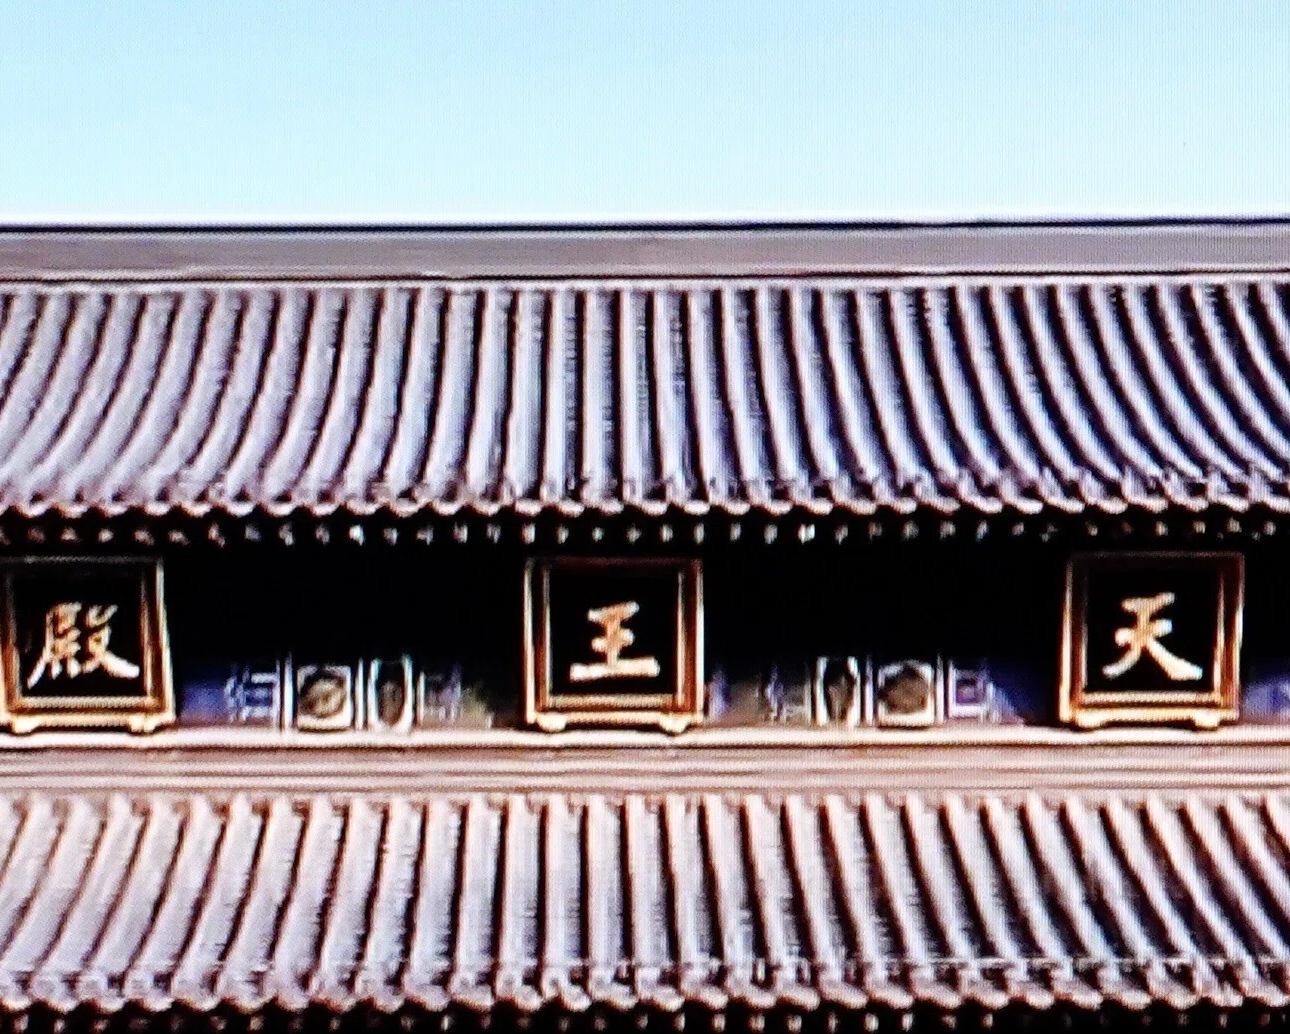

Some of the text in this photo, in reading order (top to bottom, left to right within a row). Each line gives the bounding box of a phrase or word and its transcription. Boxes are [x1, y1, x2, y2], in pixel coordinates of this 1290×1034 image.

[25, 602, 140, 689] 殿
[569, 601, 661, 682] 王
[1102, 591, 1204, 682] 天
